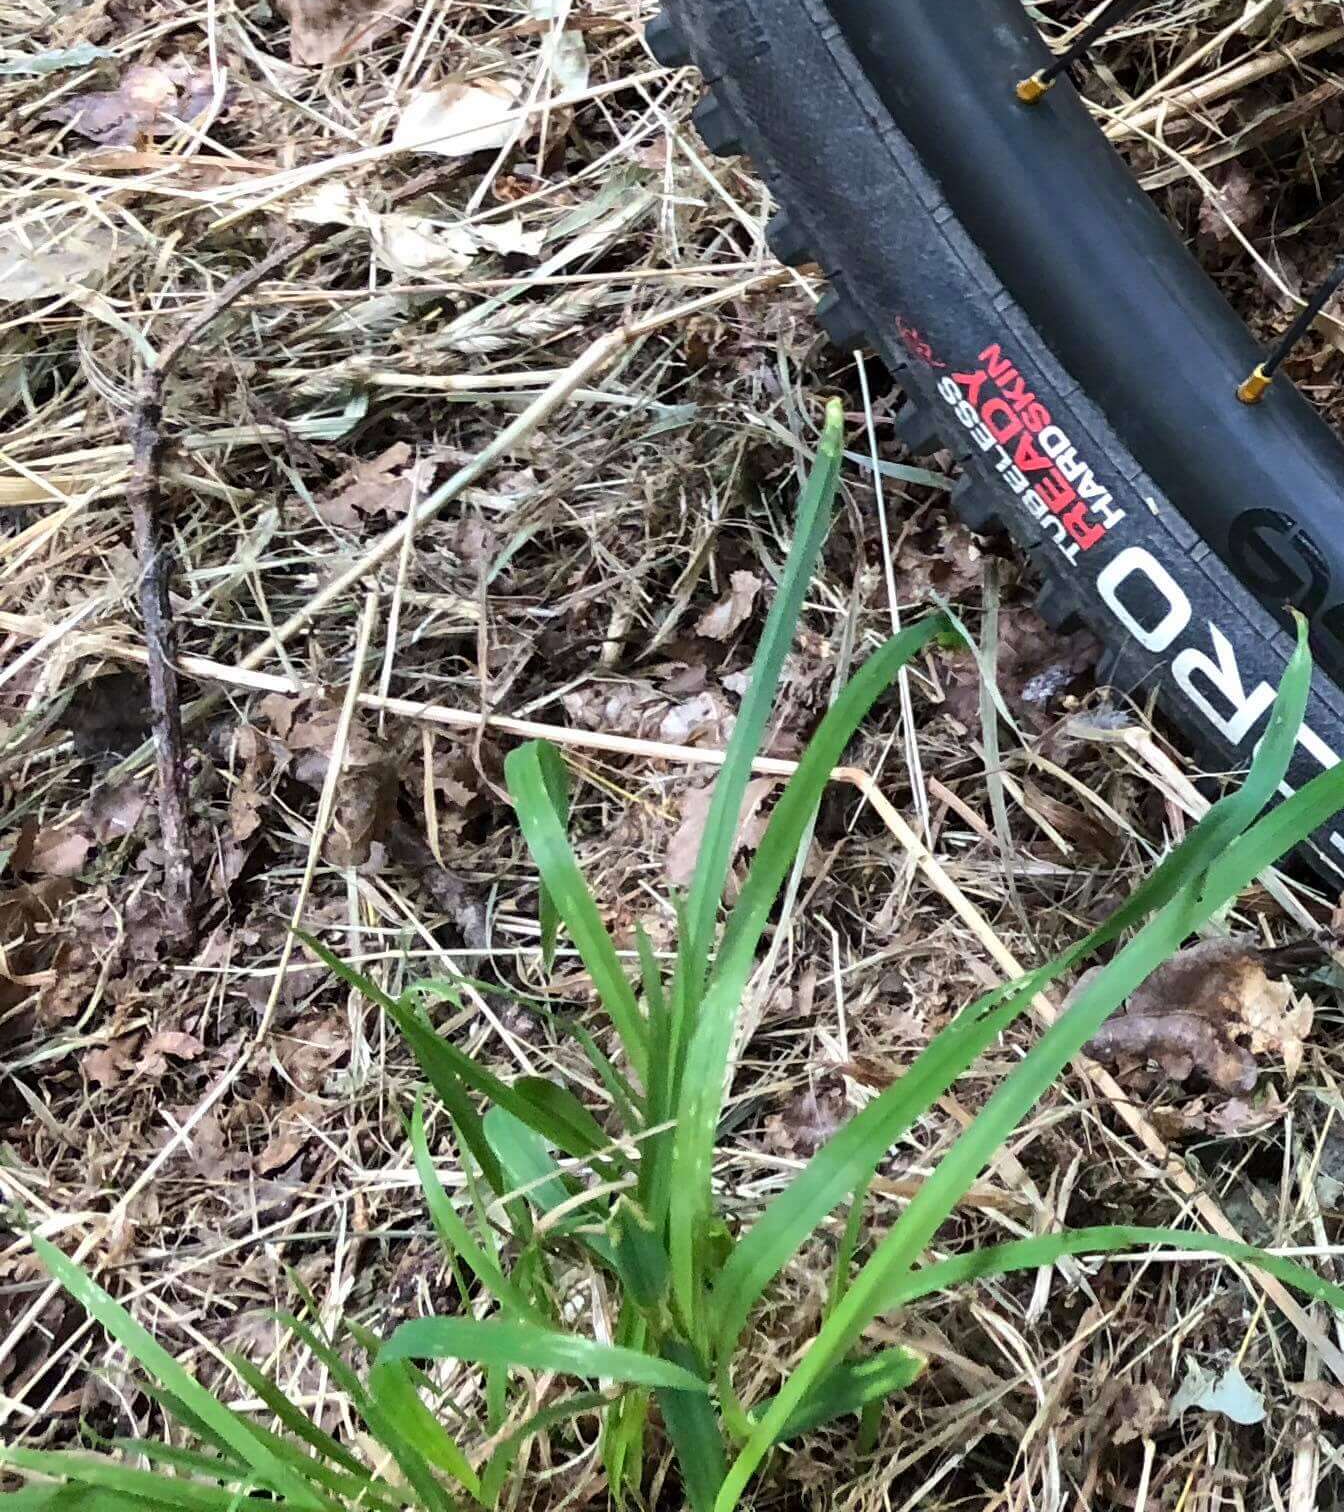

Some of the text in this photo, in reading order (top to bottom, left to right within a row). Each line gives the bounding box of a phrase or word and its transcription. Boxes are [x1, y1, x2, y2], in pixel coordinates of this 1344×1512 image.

[936, 375, 1081, 568] TUBELESS
[951, 369, 1107, 552] READY
[977, 343, 1127, 530] HARDSKIN
